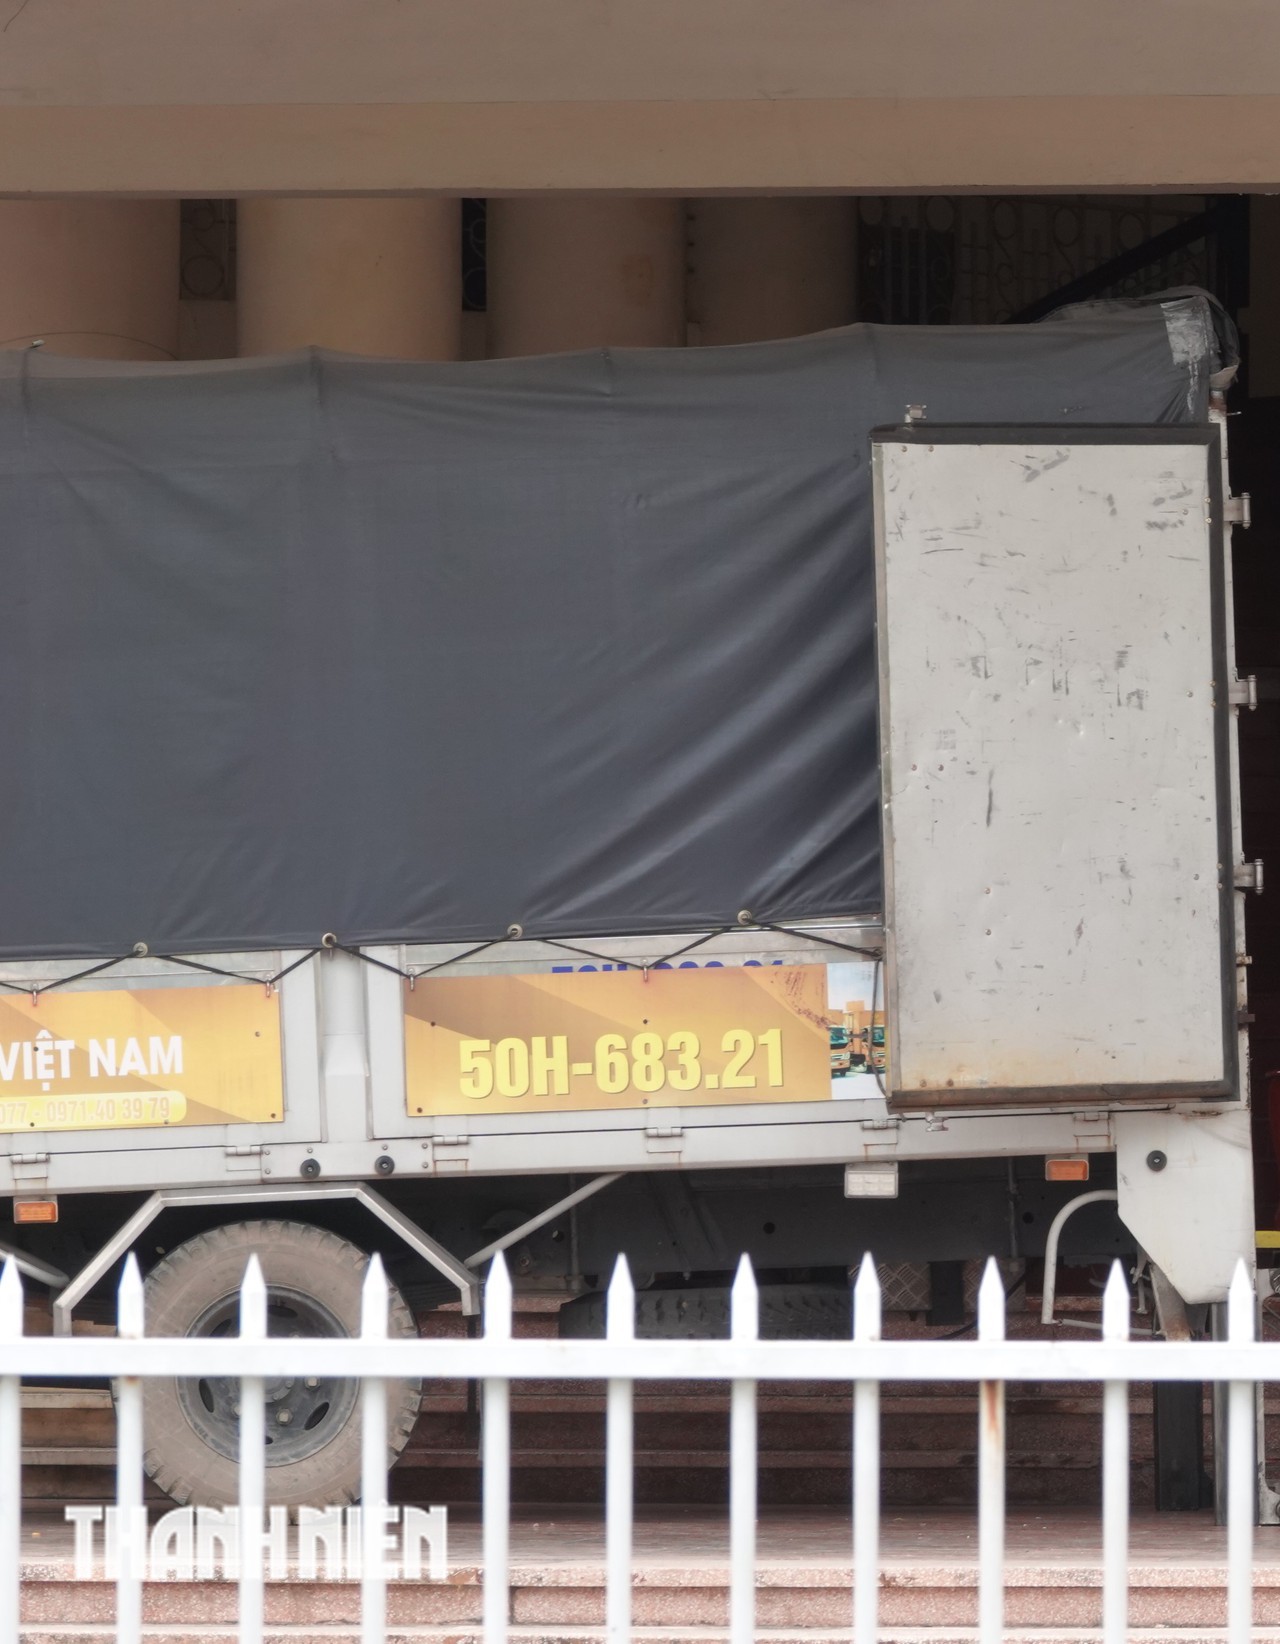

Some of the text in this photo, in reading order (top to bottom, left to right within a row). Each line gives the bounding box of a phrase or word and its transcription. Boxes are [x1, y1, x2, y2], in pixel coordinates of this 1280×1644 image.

[0, 1029, 183, 1091] VIỆT NAM
[459, 1028, 785, 1099] 50H-683.21
[46, 1098, 116, 1122] 0971.40
[122, 1098, 143, 1119] 39
[149, 1096, 170, 1118] 79
